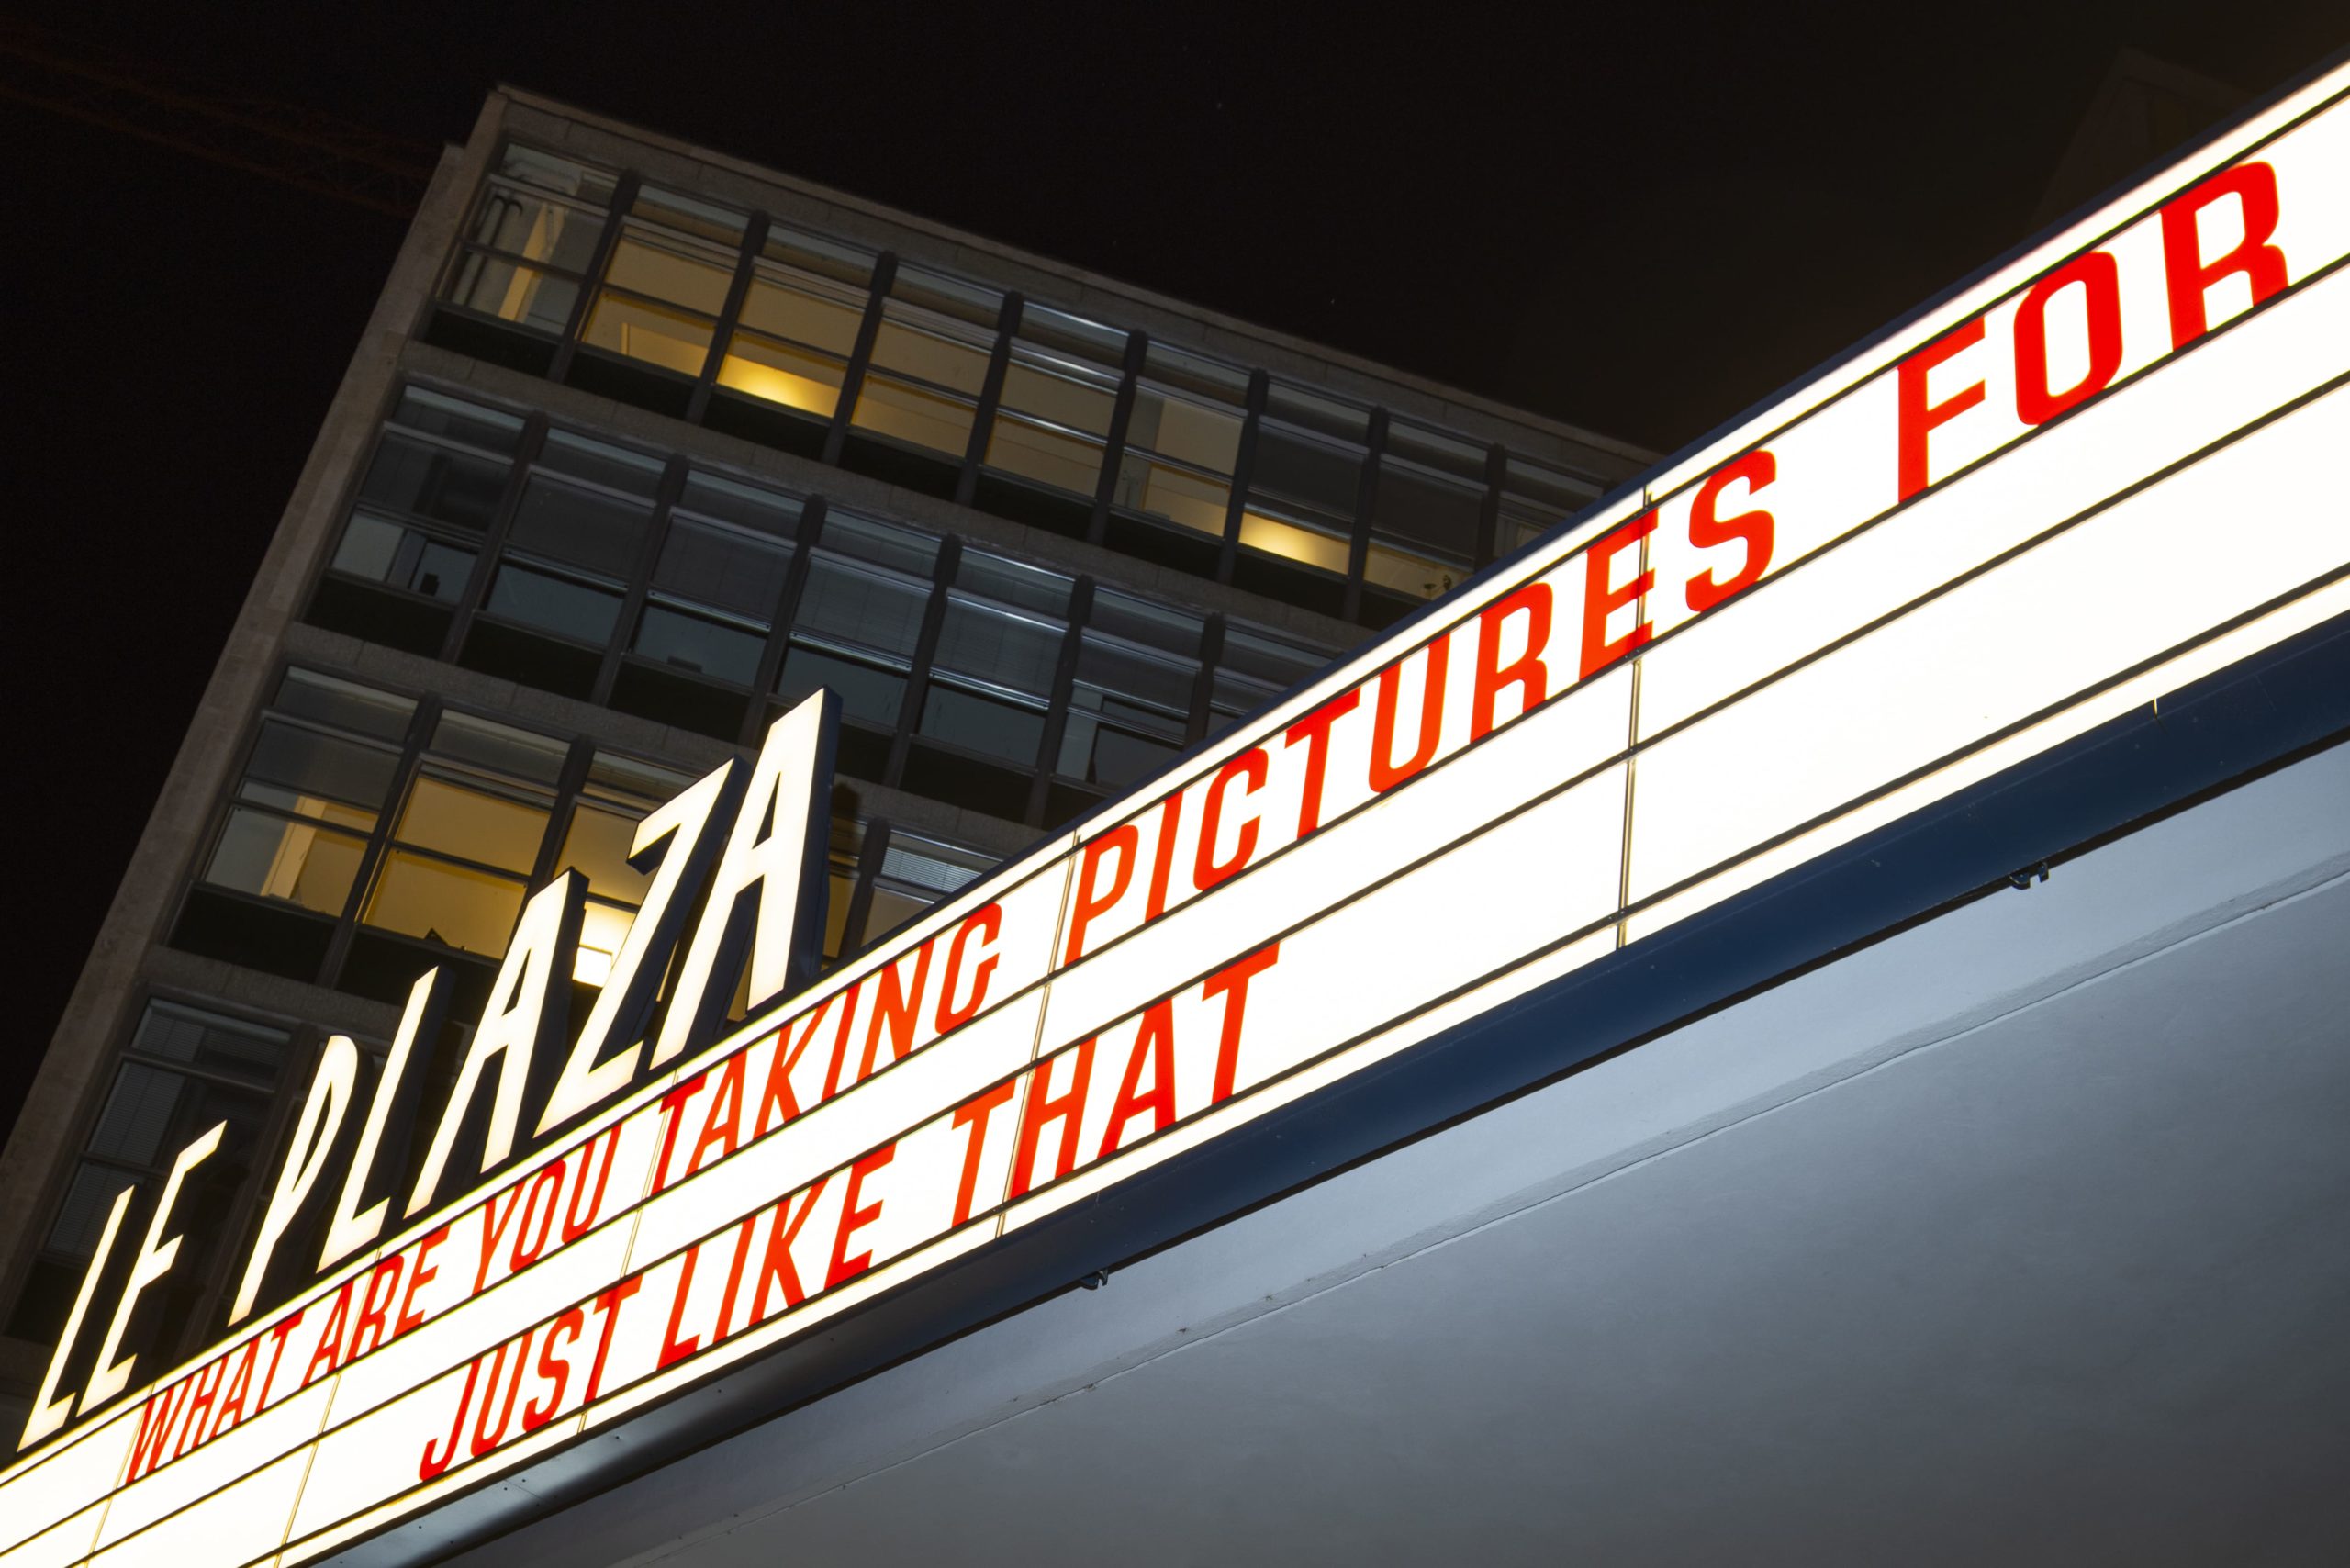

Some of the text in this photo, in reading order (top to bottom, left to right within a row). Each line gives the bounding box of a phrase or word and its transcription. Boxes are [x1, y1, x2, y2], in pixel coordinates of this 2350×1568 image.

[17, 687, 830, 1454] LE PLAZA
[125, 161, 2290, 1484] WHAT ARE YOU TAKING PICTURES FOR
[418, 940, 1281, 1484] JUST LIKE THAT
